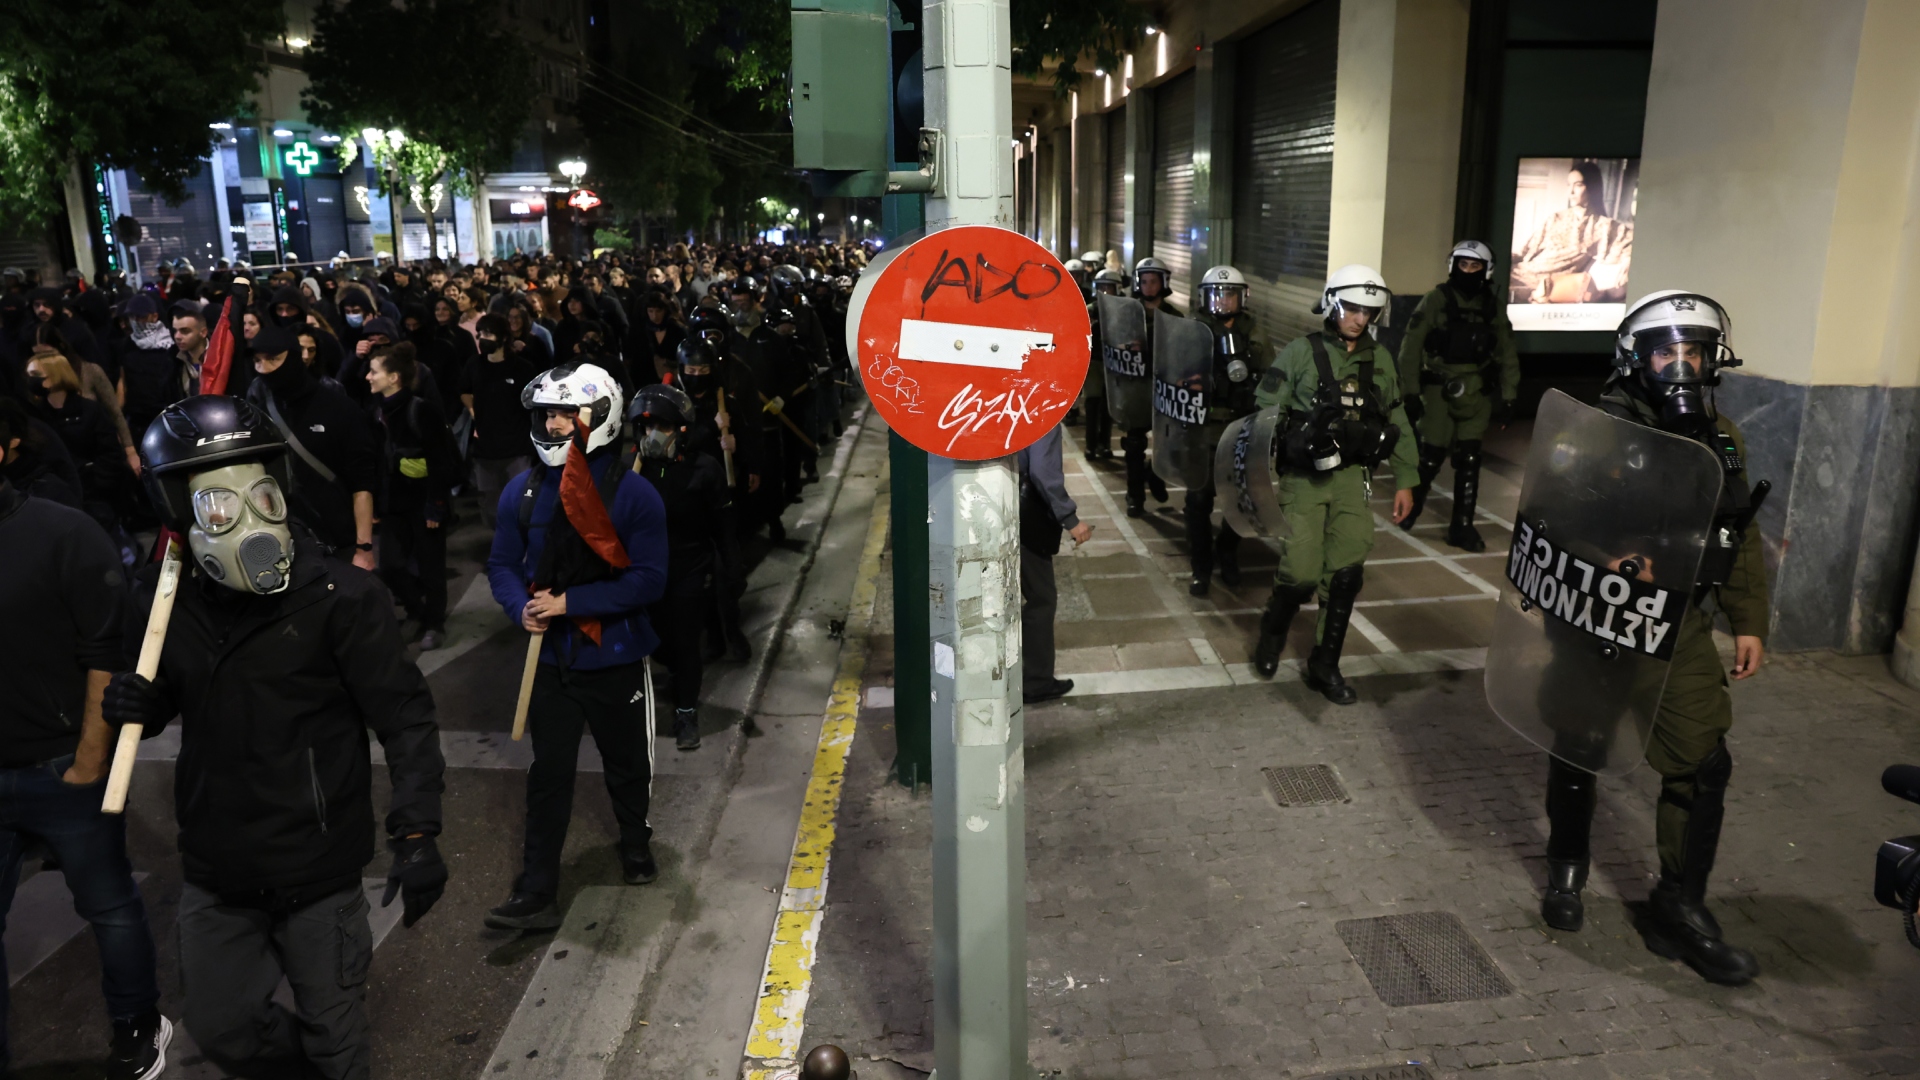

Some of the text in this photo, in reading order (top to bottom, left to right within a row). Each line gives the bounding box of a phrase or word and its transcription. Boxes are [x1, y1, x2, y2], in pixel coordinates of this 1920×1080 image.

[94, 163, 113, 244] pharmcy
[1104, 345, 1142, 363] POLIC
[1155, 393, 1207, 425] ΑΣΤΥΝΟ
[1156, 379, 1203, 407] POLIC
[196, 431, 251, 447] LS2
[1518, 521, 1669, 619] POLICE
[1509, 544, 1671, 654] ΑΣΤΥΝΟΜΙΑ
